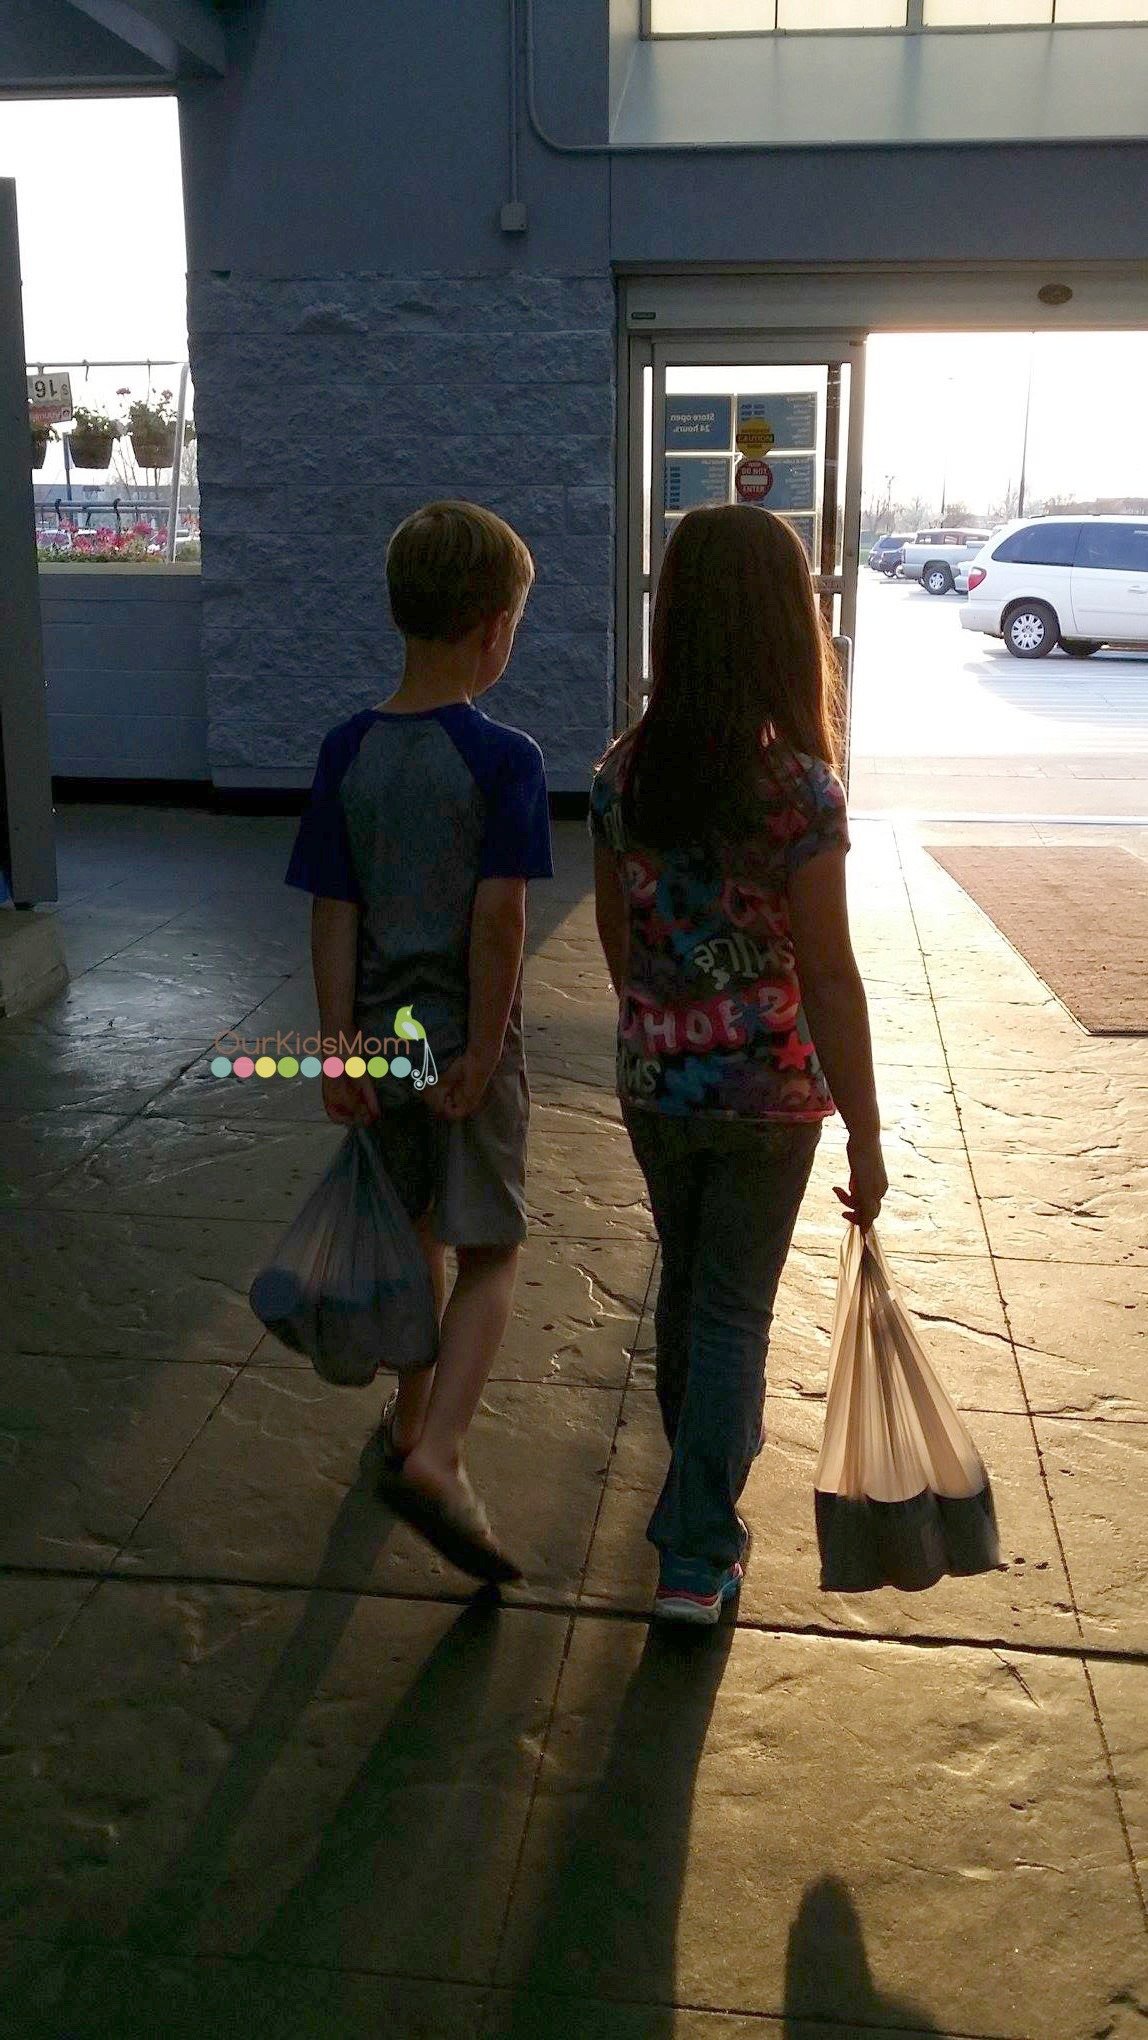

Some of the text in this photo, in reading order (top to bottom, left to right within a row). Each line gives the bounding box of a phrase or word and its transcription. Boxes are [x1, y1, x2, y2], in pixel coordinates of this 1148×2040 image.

[741, 466, 767, 475] DO NOT
[742, 485, 766, 493] ENTER
